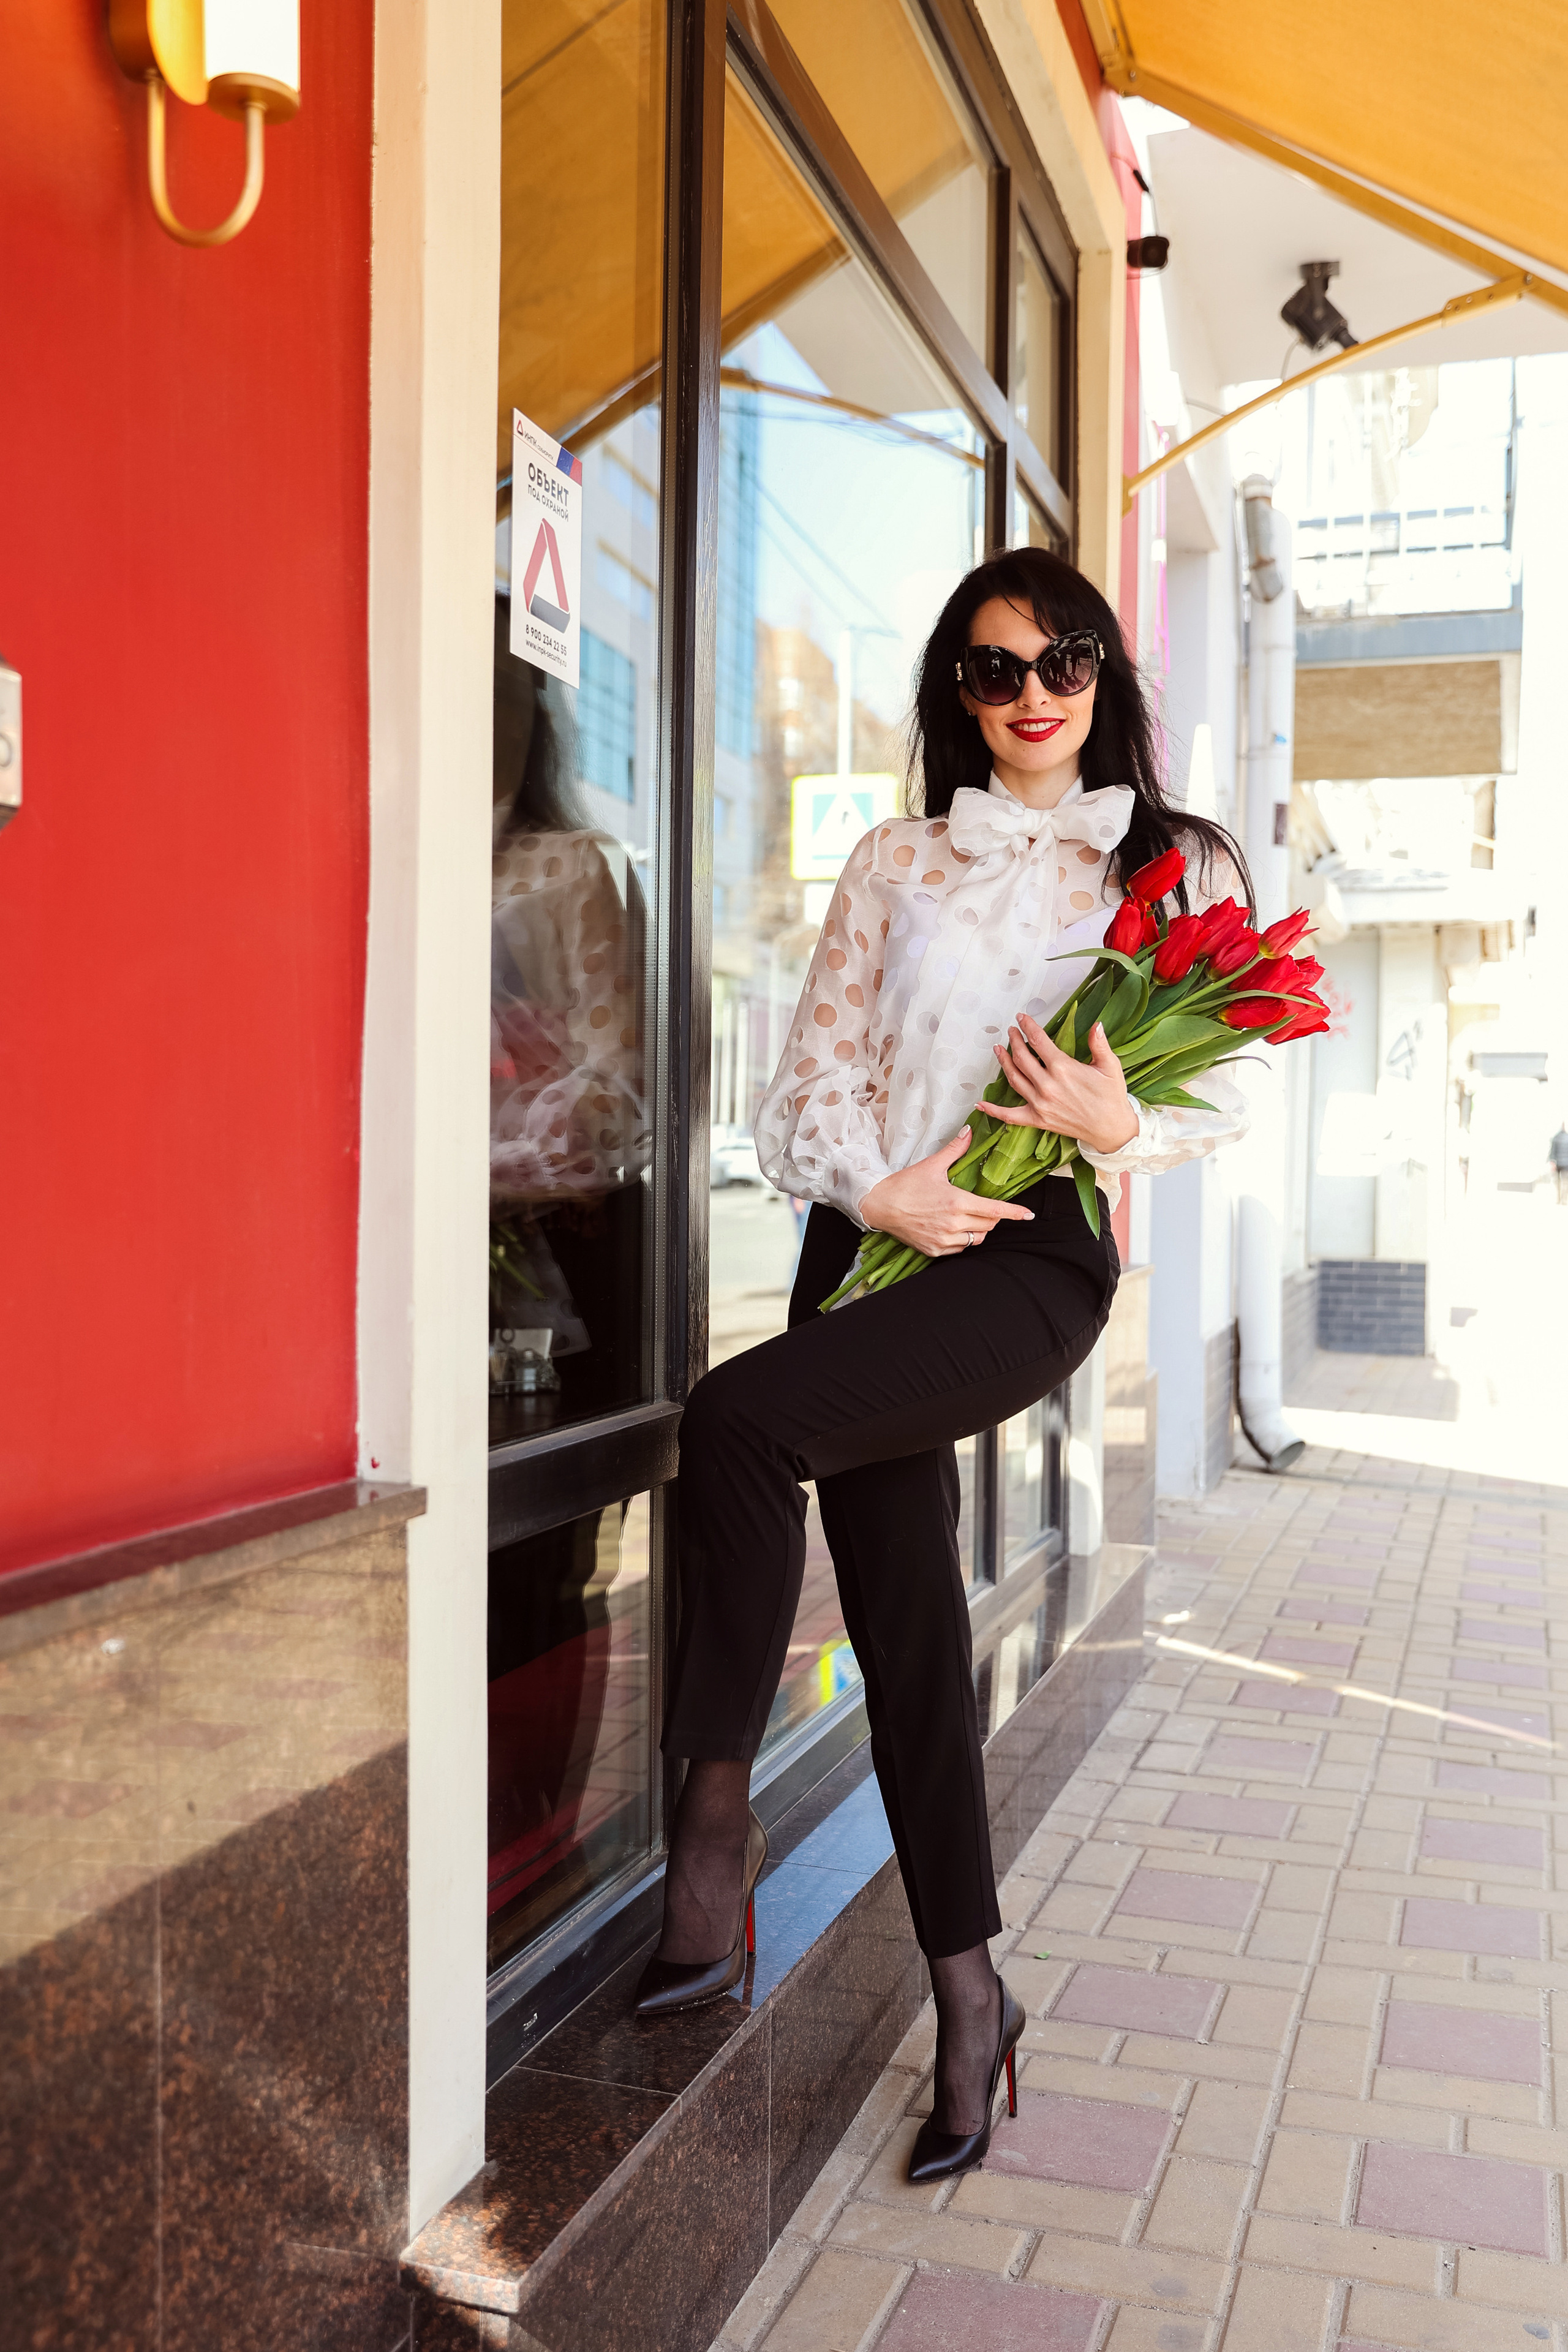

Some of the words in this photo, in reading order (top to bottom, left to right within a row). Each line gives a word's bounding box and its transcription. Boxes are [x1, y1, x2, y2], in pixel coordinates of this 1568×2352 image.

[524, 431, 537, 448] ИНПК
[528, 462, 569, 507] ОБЪЕКТ
[528, 484, 540, 502] ПОД
[542, 495, 569, 522] ОХРАНОЙ
[526, 624, 529, 634] 8
[530, 627, 541, 641] 900
[543, 634, 552, 647] 234
[554, 640, 559, 652] 22
[560, 644, 567, 656] 55
[526, 639, 567, 667] www.inpk-security.ru
